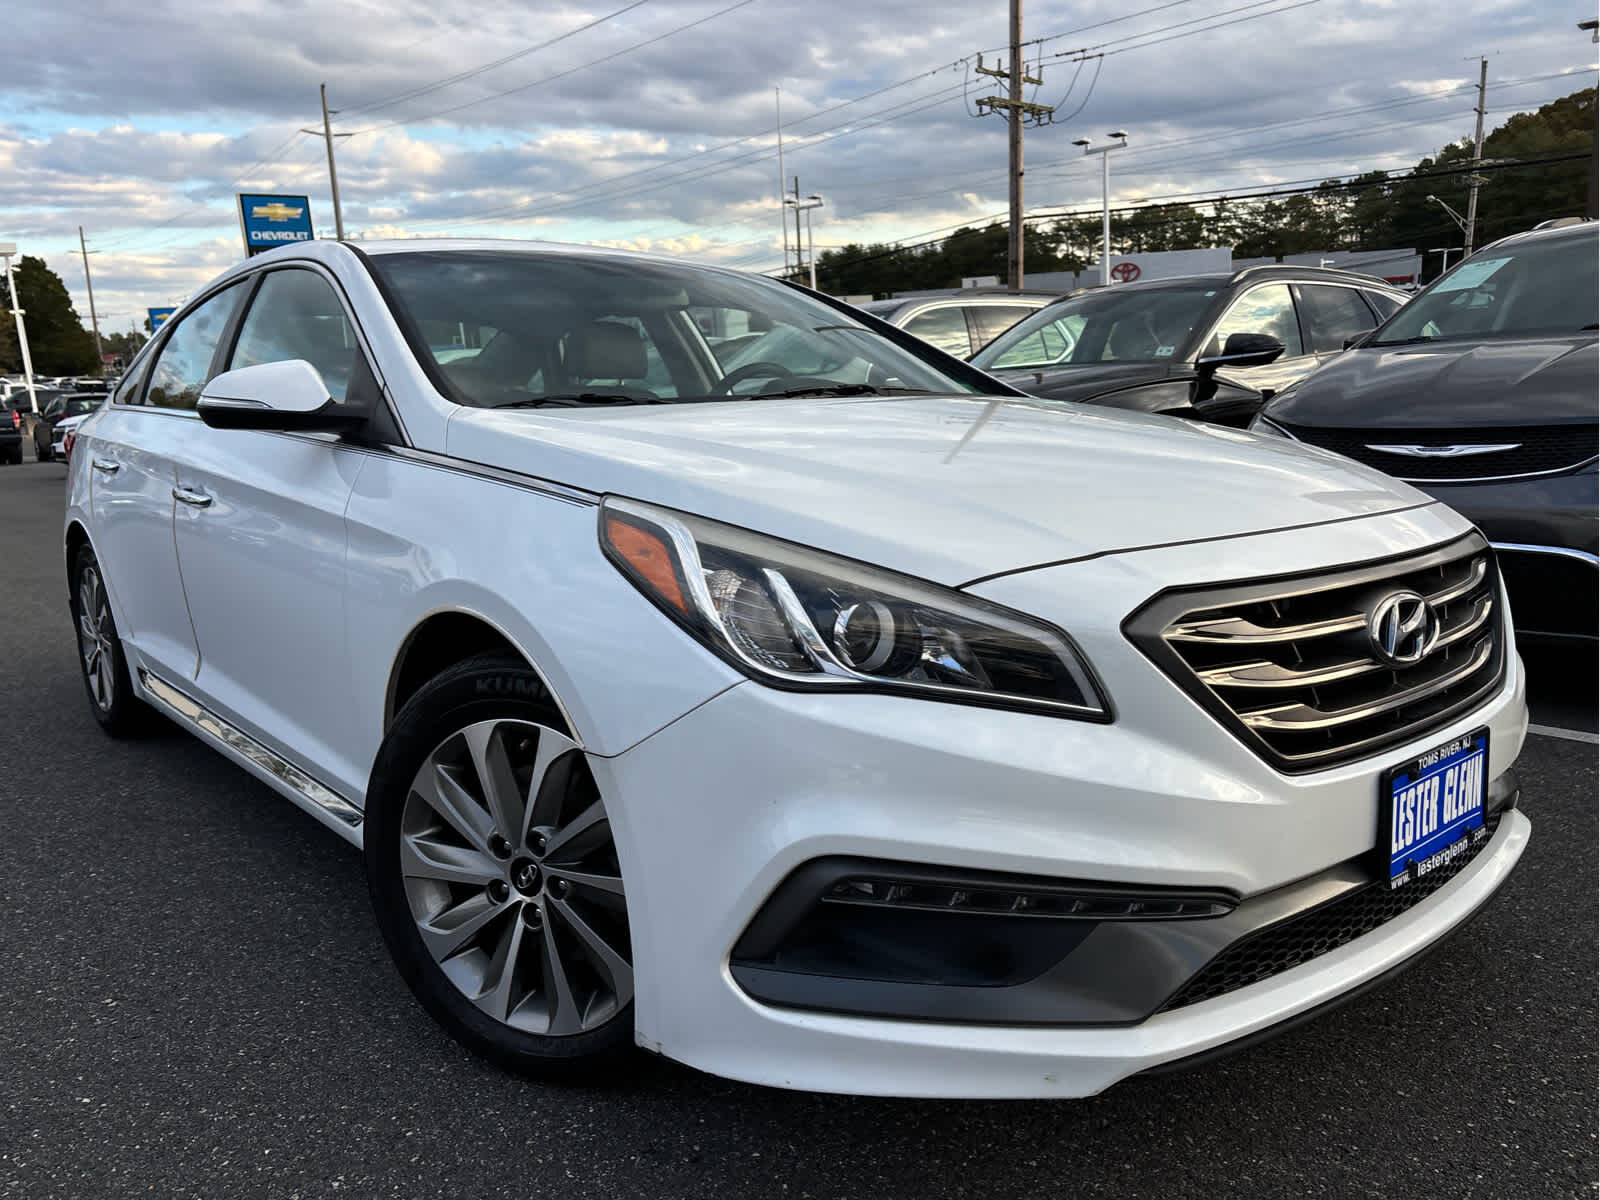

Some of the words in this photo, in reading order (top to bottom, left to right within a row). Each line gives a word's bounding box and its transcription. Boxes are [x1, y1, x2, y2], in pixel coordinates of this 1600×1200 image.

[251, 231, 308, 240] CHEVROLET
[1418, 752, 1439, 770] TOMS
[1462, 735, 1472, 750] NJ
[1391, 775, 1440, 855] LESTER
[1443, 753, 1483, 824] GLENN
[1417, 838, 1468, 878] lesterglenn
